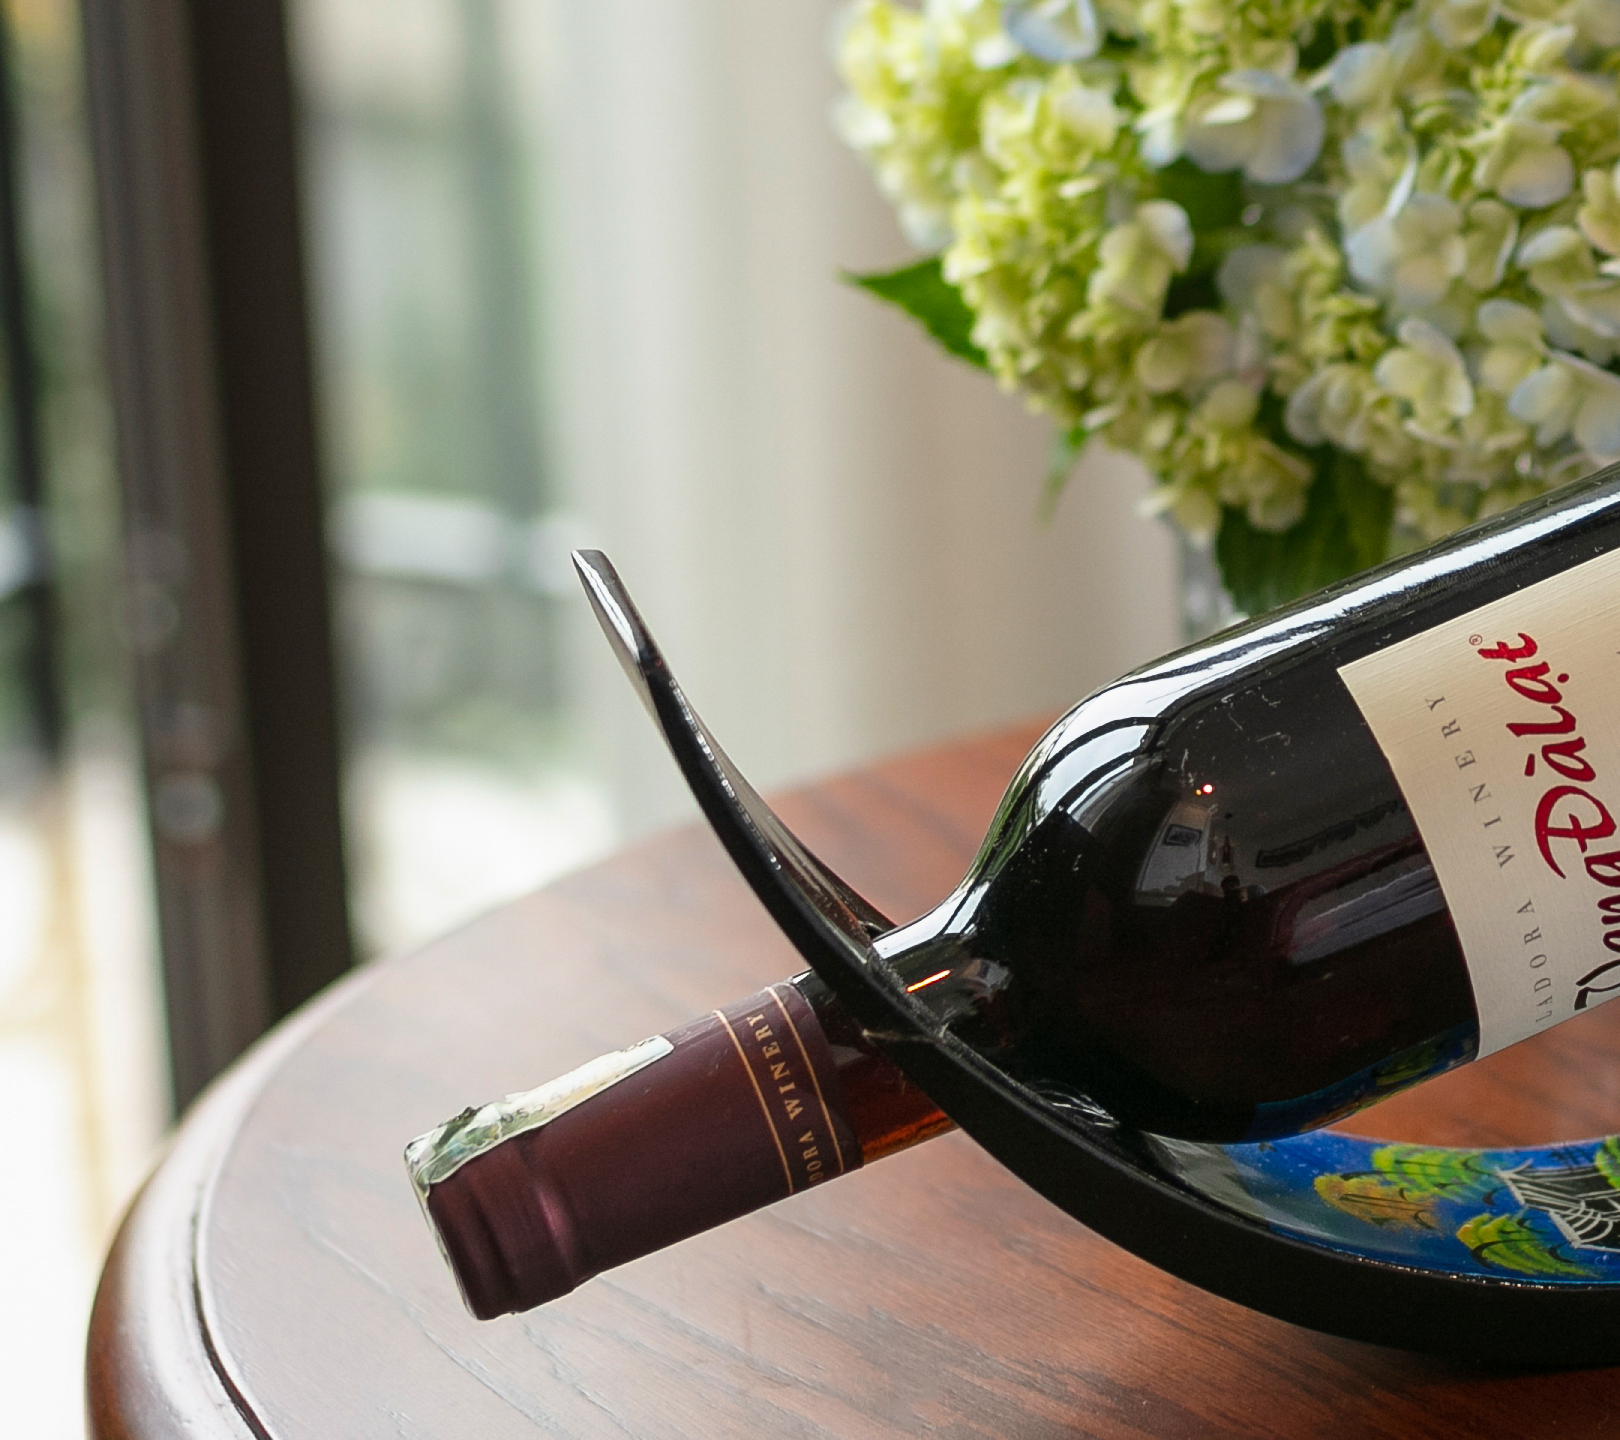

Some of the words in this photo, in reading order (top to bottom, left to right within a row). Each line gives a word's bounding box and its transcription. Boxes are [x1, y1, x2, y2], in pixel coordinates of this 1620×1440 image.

[1425, 694, 1516, 868] WINERY
[1516, 898, 1554, 1024] LADORA
[746, 1013, 804, 1121] WINERY
[798, 1129, 825, 1185] DORA
